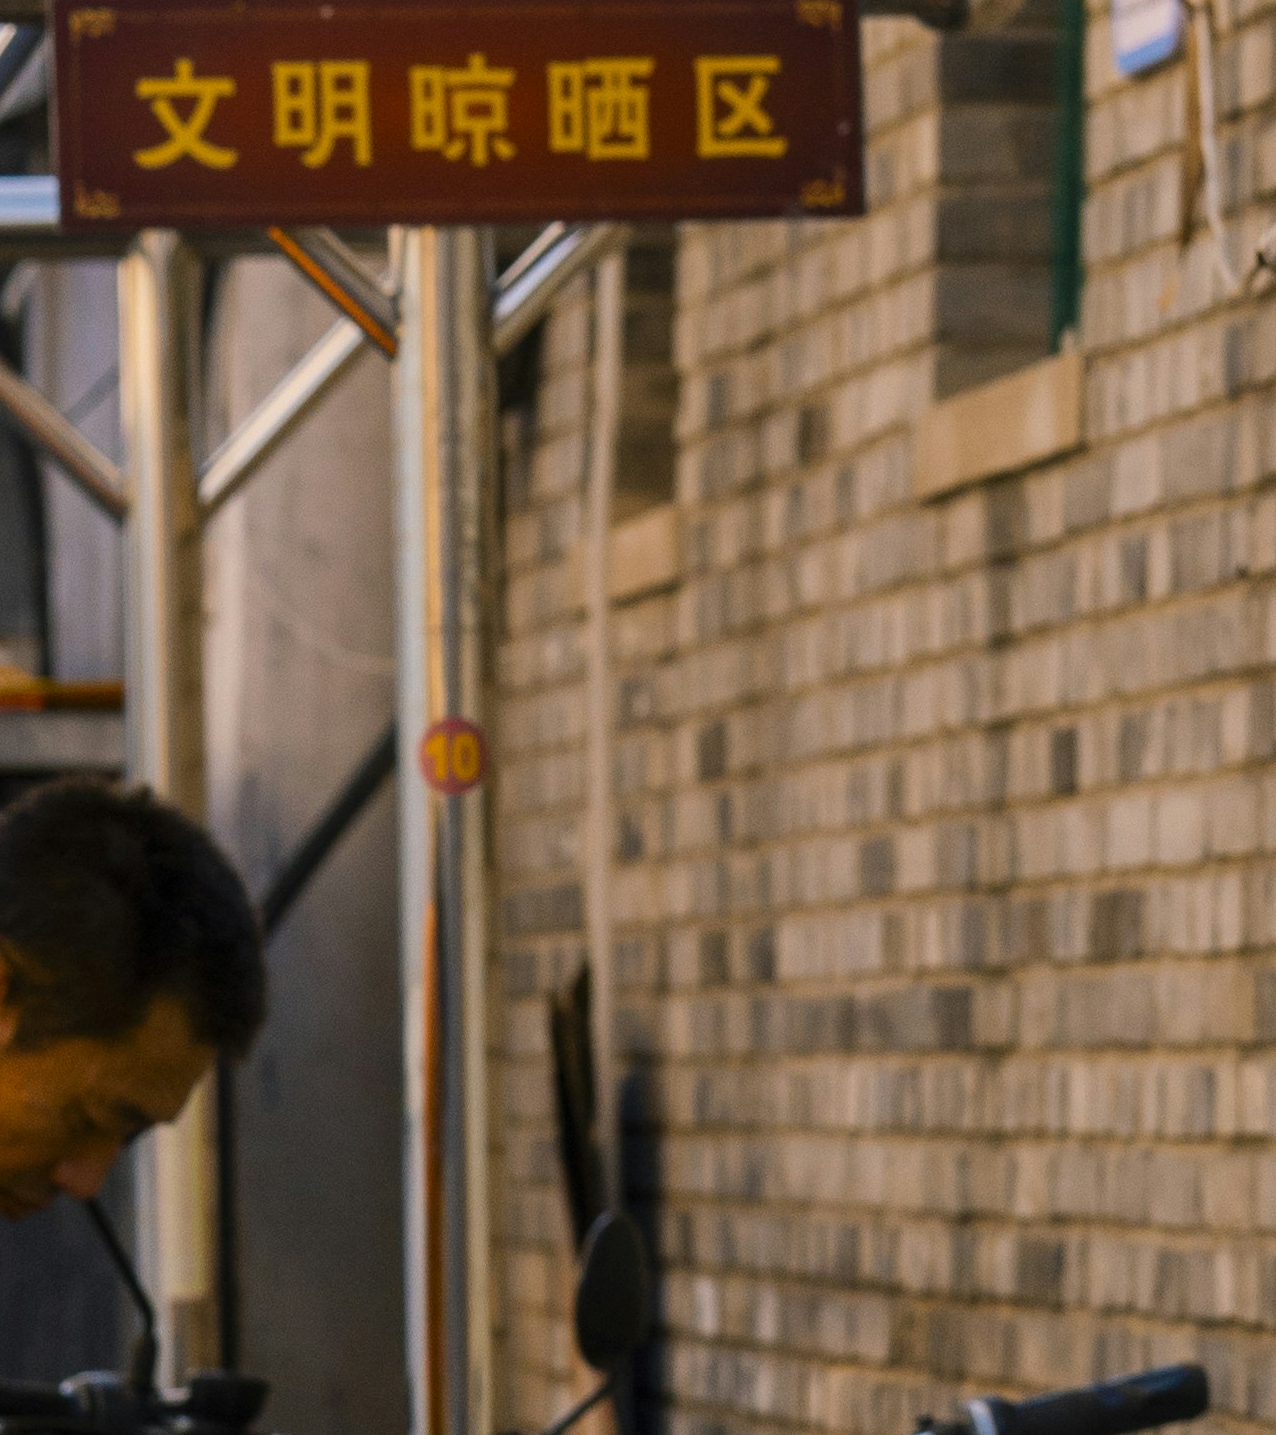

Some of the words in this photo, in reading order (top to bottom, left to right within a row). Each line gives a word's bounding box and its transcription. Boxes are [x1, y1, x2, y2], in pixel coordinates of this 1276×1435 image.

[132, 52, 788, 171] 文明晾晒区
[425, 732, 480, 782] 10
